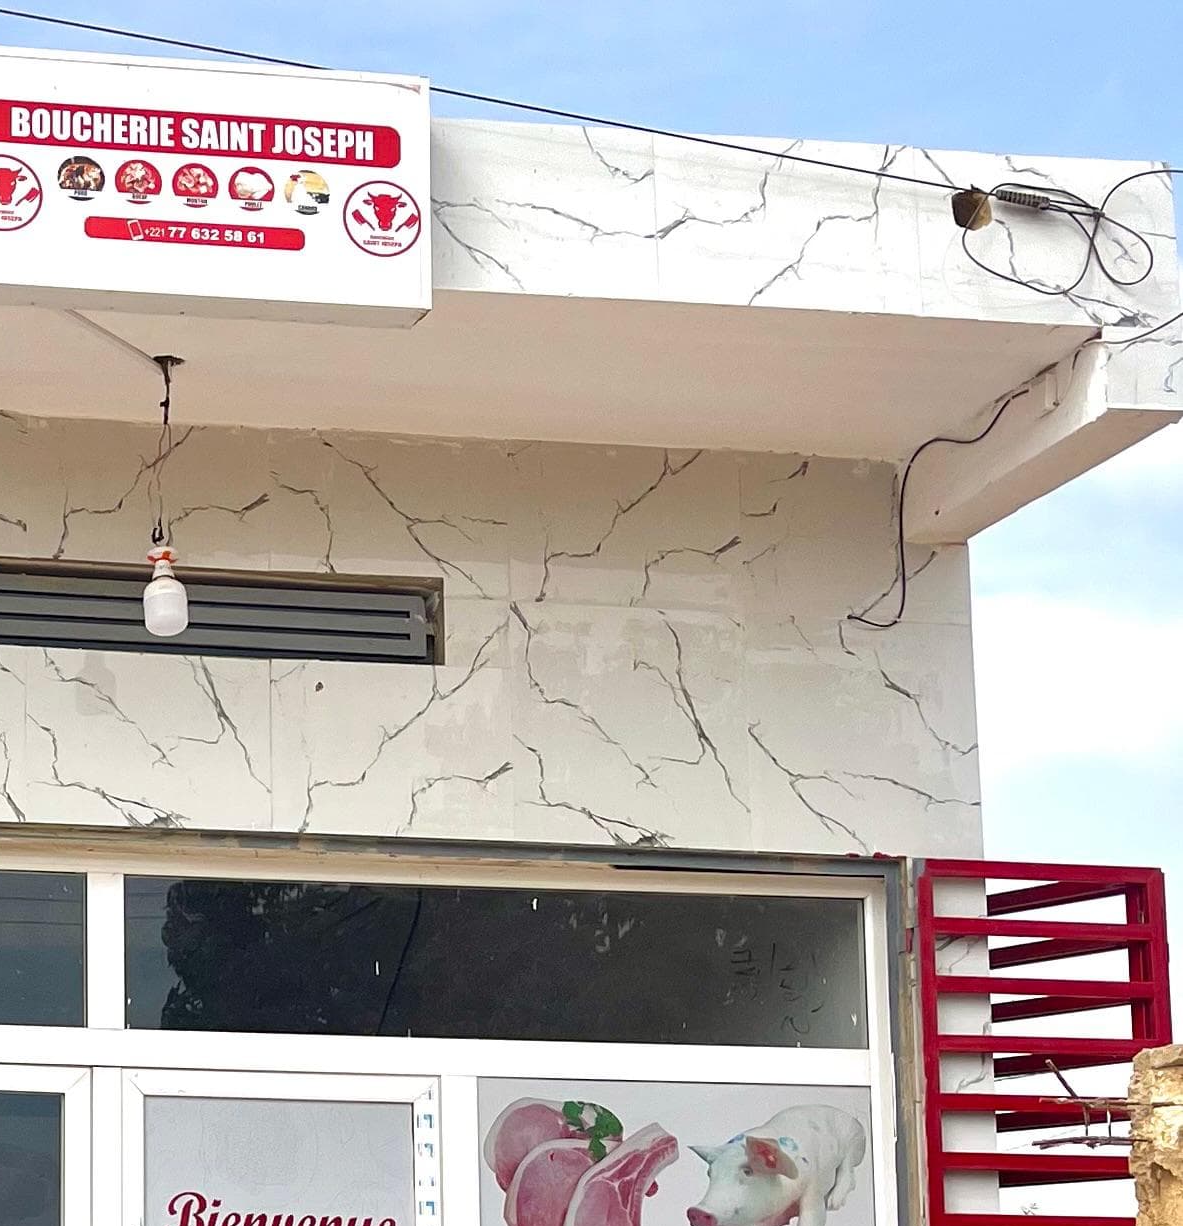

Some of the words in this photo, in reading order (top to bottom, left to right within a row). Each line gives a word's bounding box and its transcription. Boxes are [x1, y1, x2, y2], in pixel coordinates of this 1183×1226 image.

[10, 106, 175, 147] BOUCHERIE
[181, 119, 266, 152] SAINT
[272, 124, 374, 161] JOSEPH
[144, 226, 165, 237] +221
[168, 226, 187, 238] 77
[191, 228, 219, 241] 632
[224, 229, 242, 242] 58
[247, 231, 265, 244] 61
